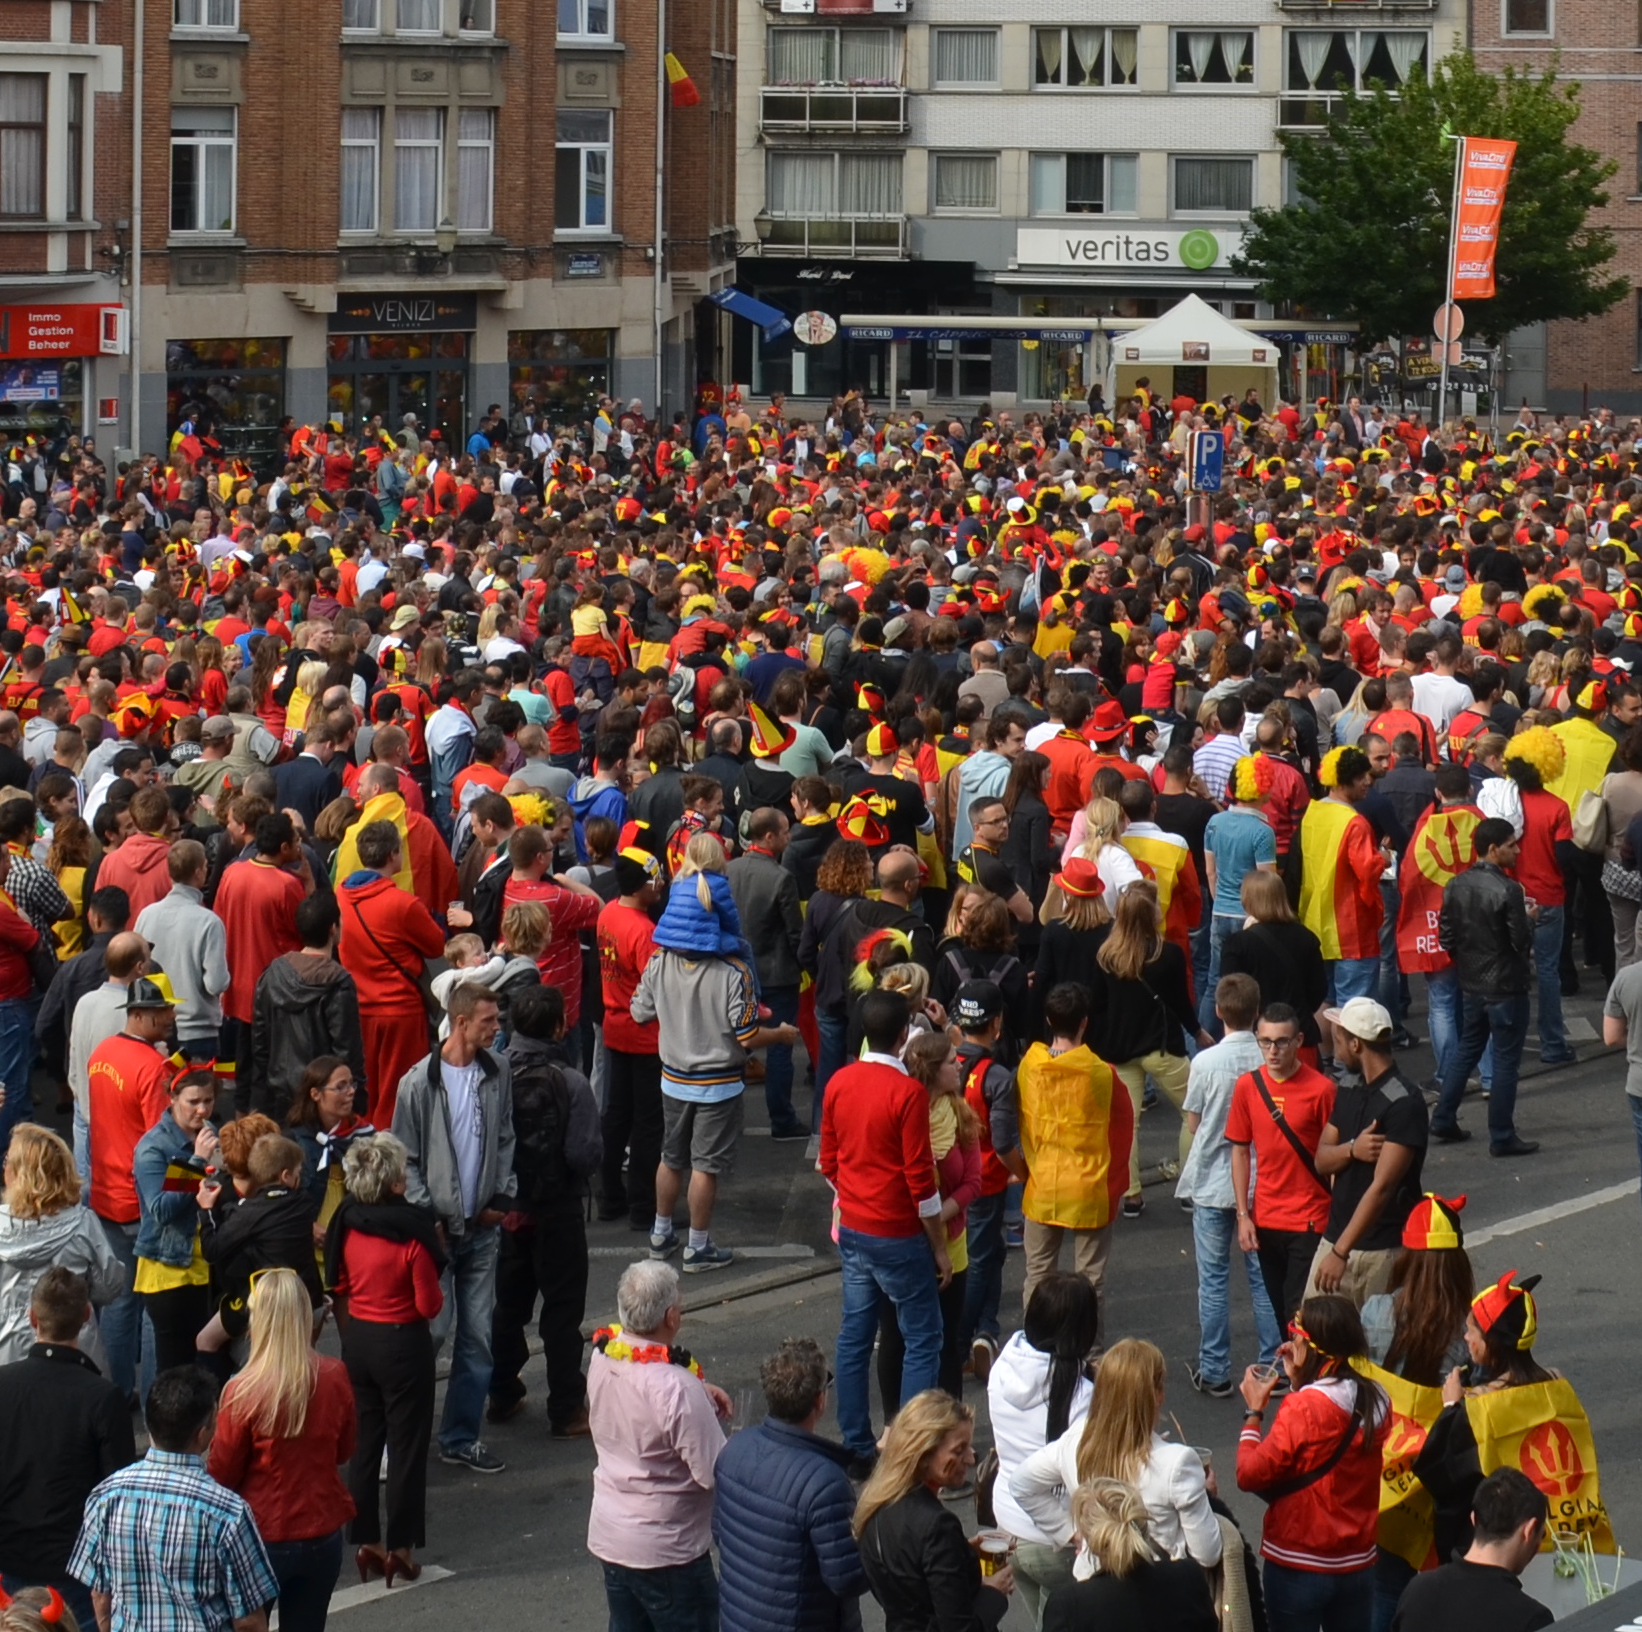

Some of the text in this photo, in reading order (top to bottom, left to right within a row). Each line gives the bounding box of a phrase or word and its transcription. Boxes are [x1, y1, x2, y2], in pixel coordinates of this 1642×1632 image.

[1065, 234, 1170, 262] veritas
[28, 312, 61, 322] Immo
[372, 299, 436, 322] VENIZI
[28, 325, 74, 336] Gestion
[850, 328, 892, 338] RICARD
[1042, 331, 1084, 341] RICARD
[1306, 333, 1349, 342] RICARD
[28, 340, 70, 350] Beheer
[1201, 435, 1217, 466] P
[1416, 936, 1447, 954] RE
[88, 1060, 125, 1092] BELGIUM
[1557, 1514, 1600, 1533] DEV
